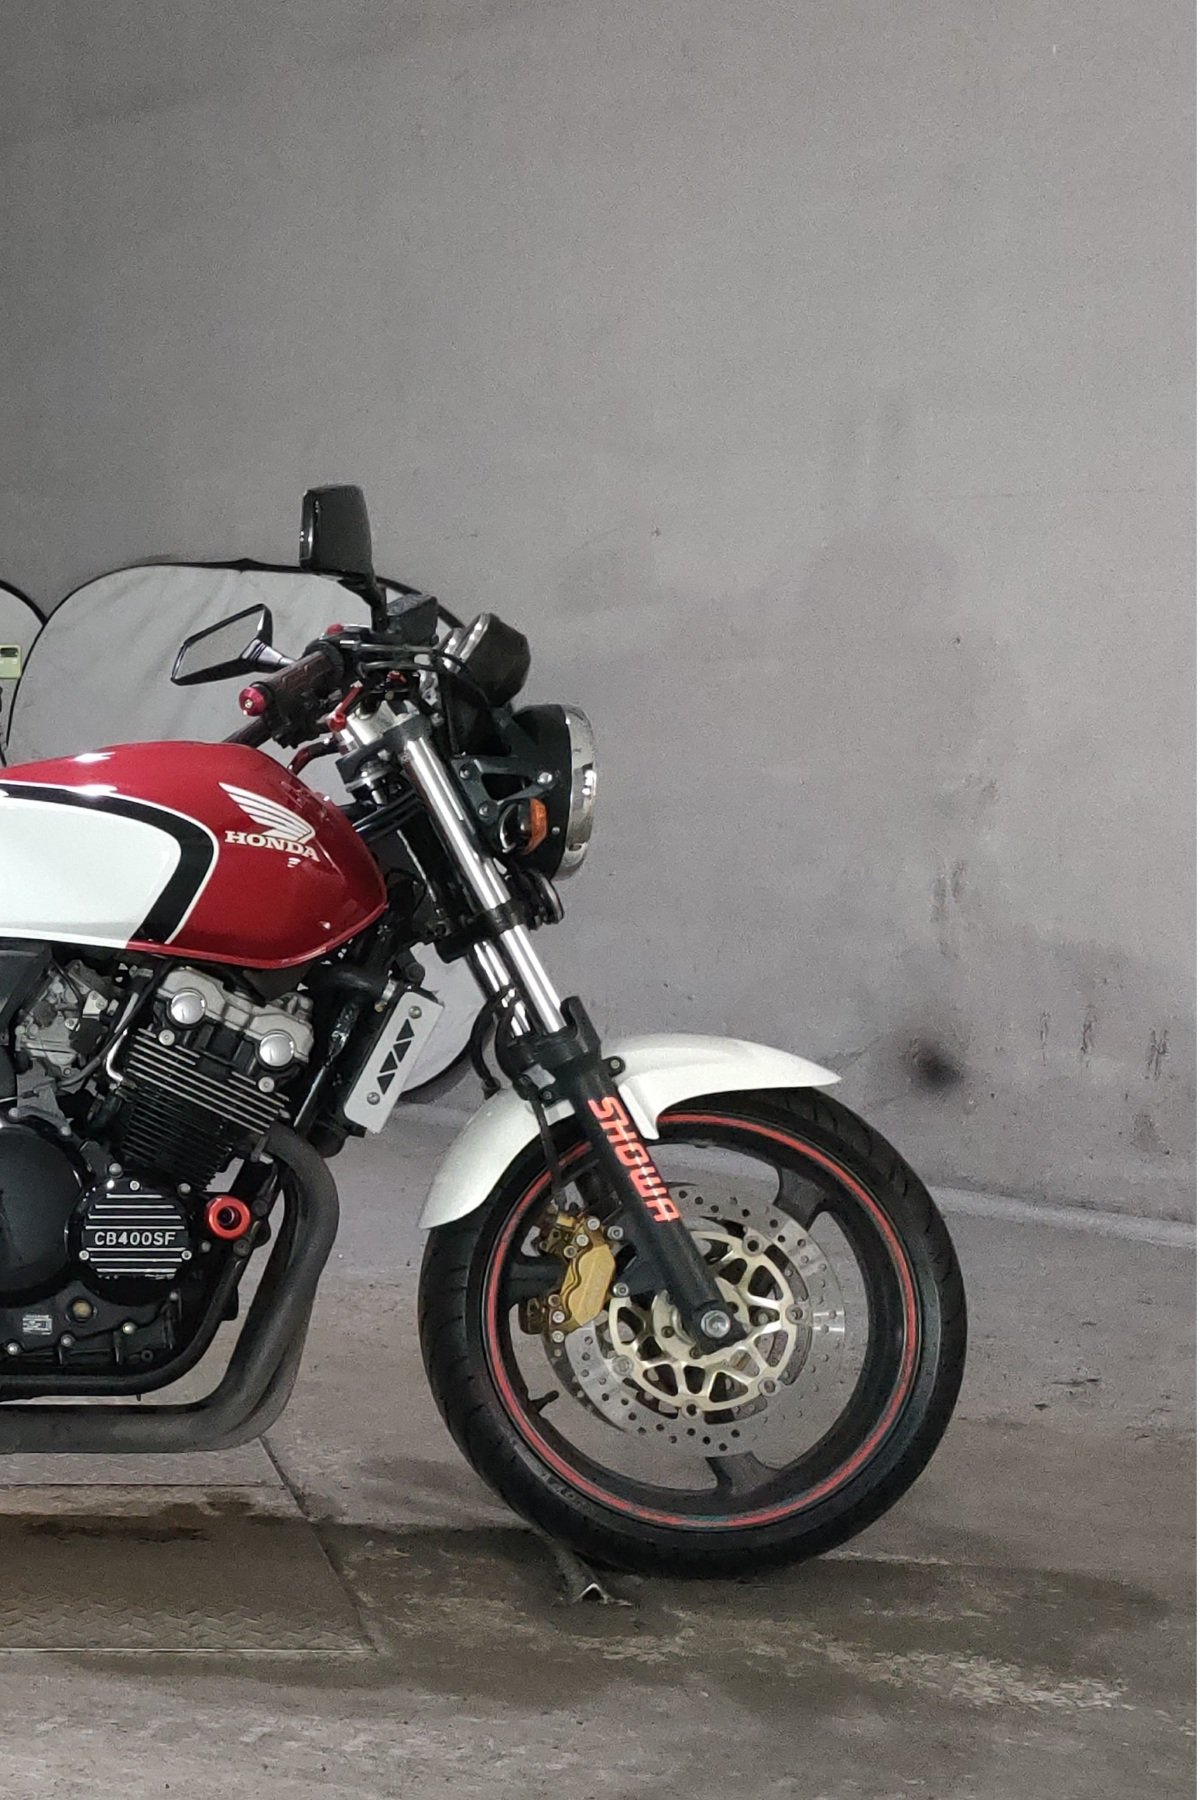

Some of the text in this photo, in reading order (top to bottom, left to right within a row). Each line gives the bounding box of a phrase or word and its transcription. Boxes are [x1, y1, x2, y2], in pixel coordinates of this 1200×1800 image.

[224, 830, 320, 862] HONDA
[587, 1096, 680, 1222] SHOWA
[94, 1231, 177, 1246] CB400SF
